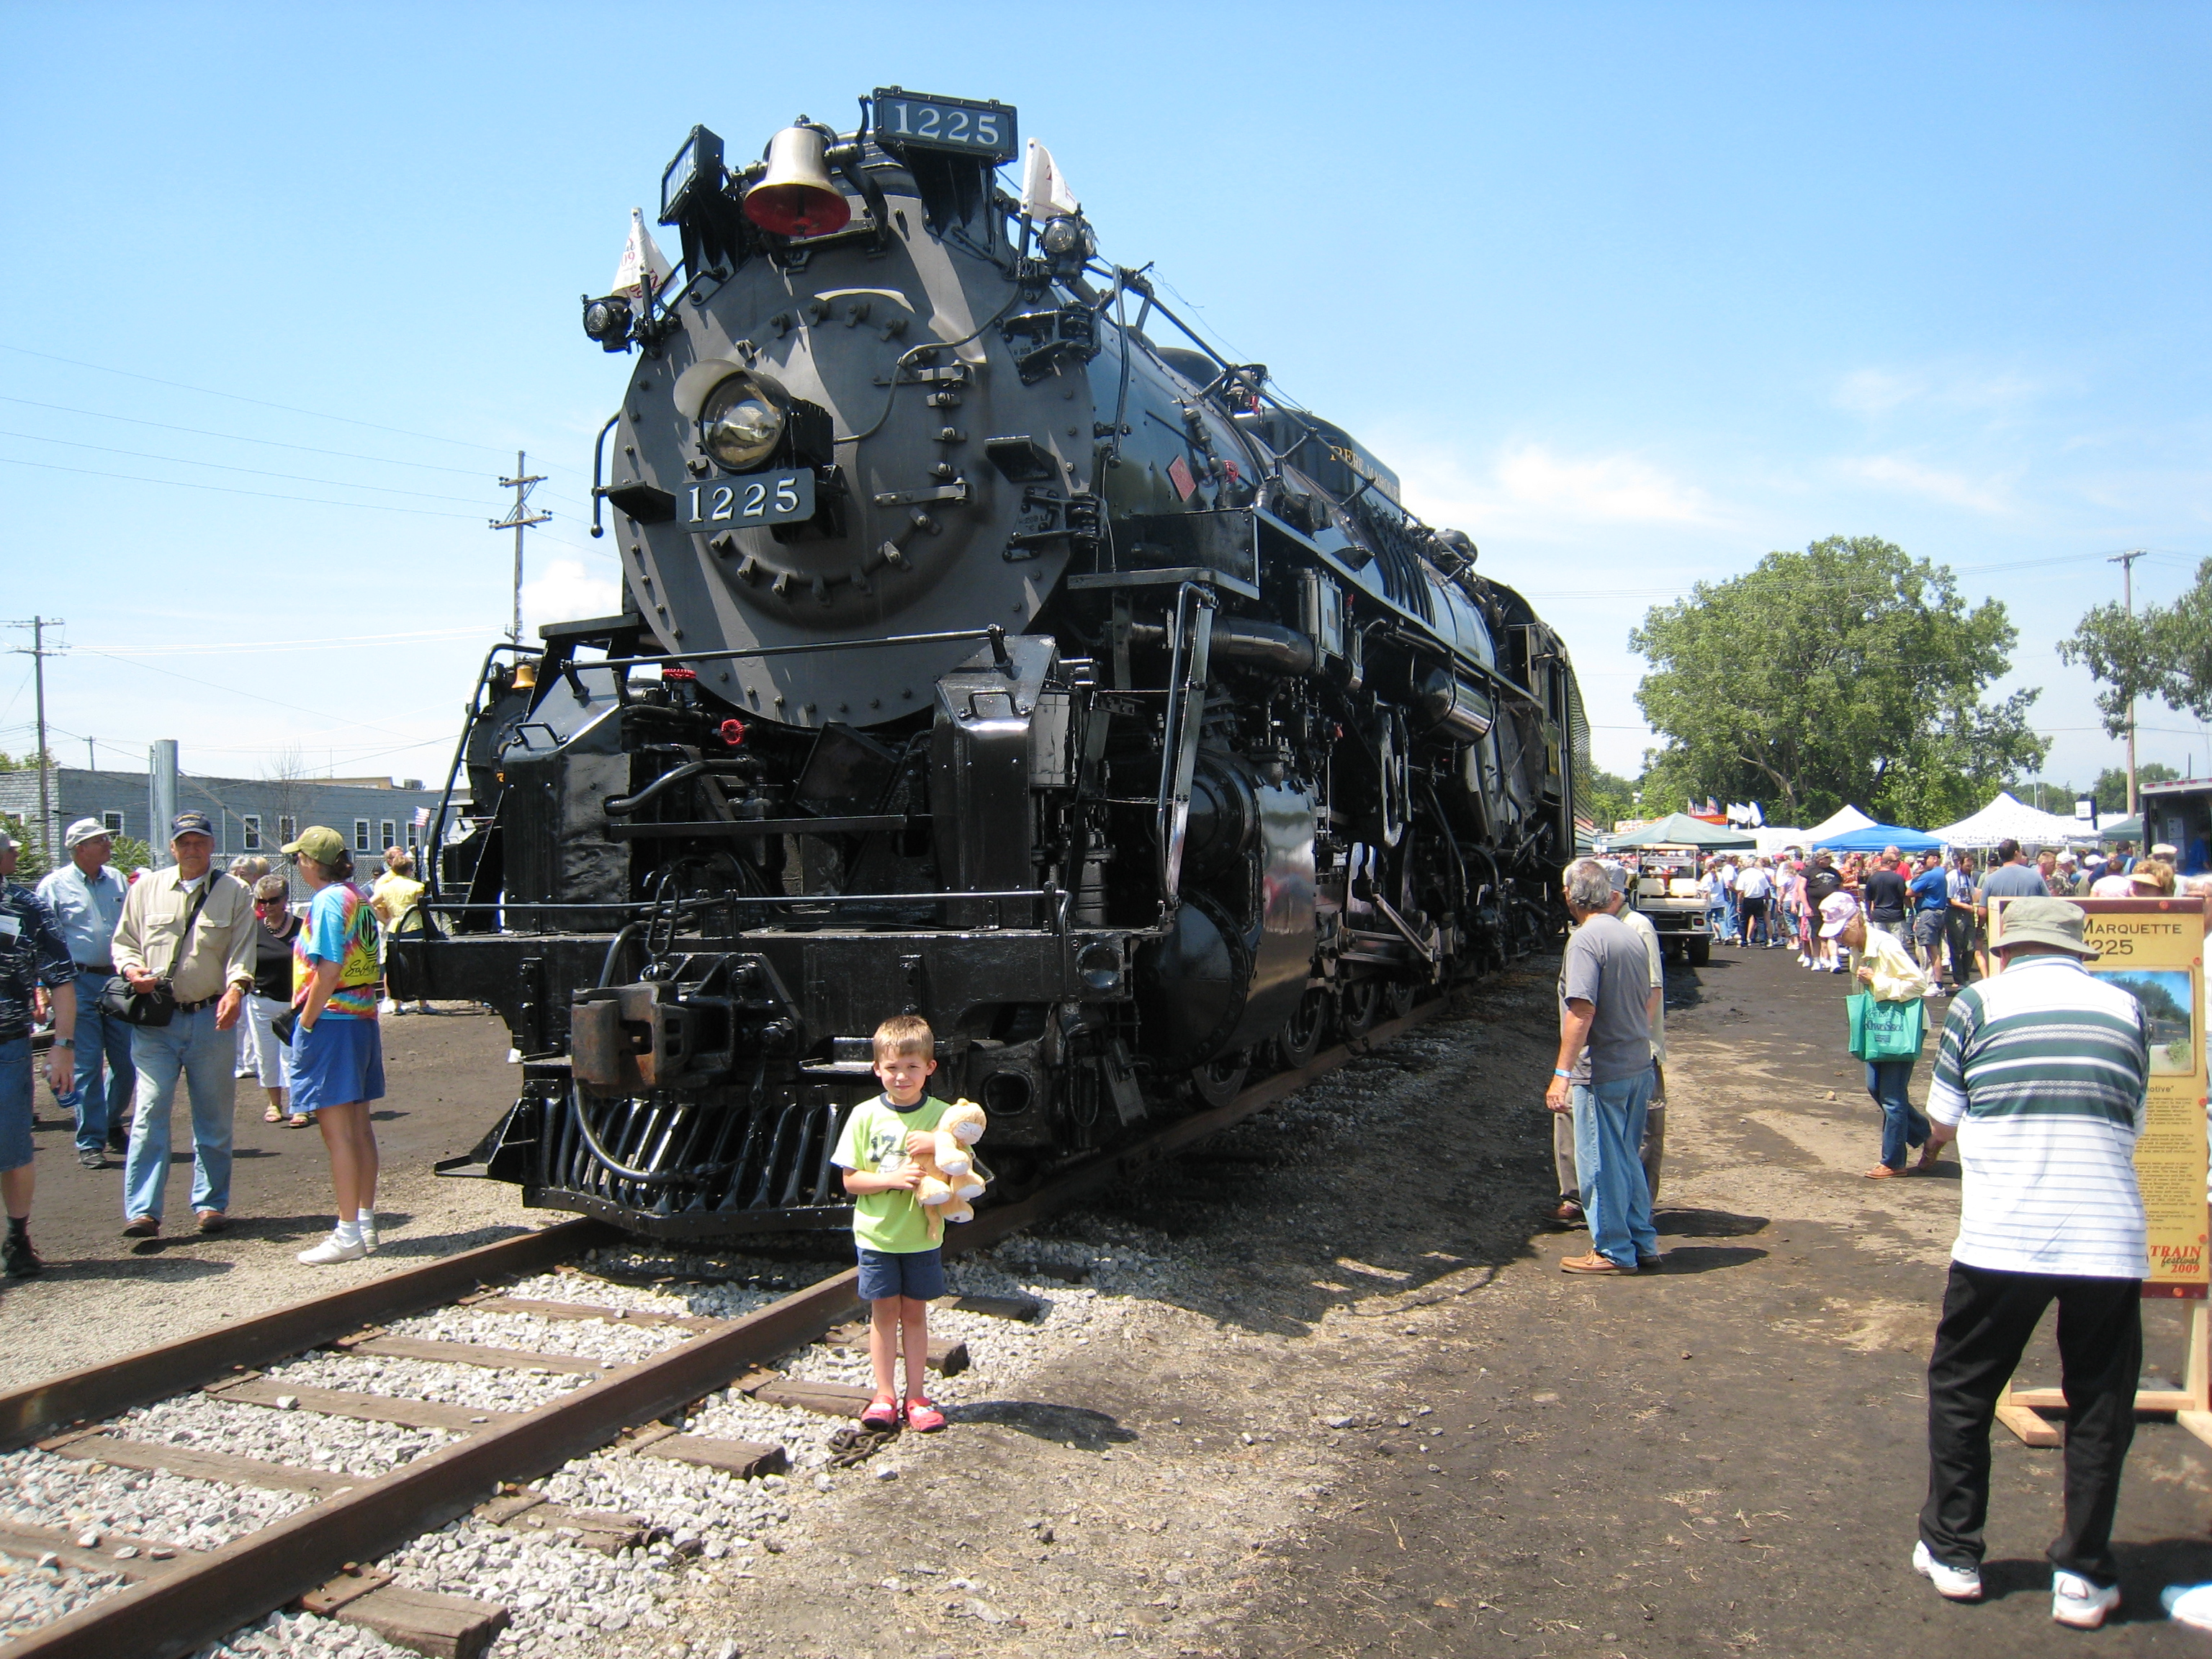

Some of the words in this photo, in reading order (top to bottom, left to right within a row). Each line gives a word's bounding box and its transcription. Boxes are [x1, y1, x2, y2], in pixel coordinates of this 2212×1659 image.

[895, 103, 999, 145] 1225
[688, 477, 799, 523] 1225
[870, 1135, 896, 1163] 17
[2150, 1245, 2202, 1258] TRAIN
[2170, 1264, 2200, 1274] 2009
